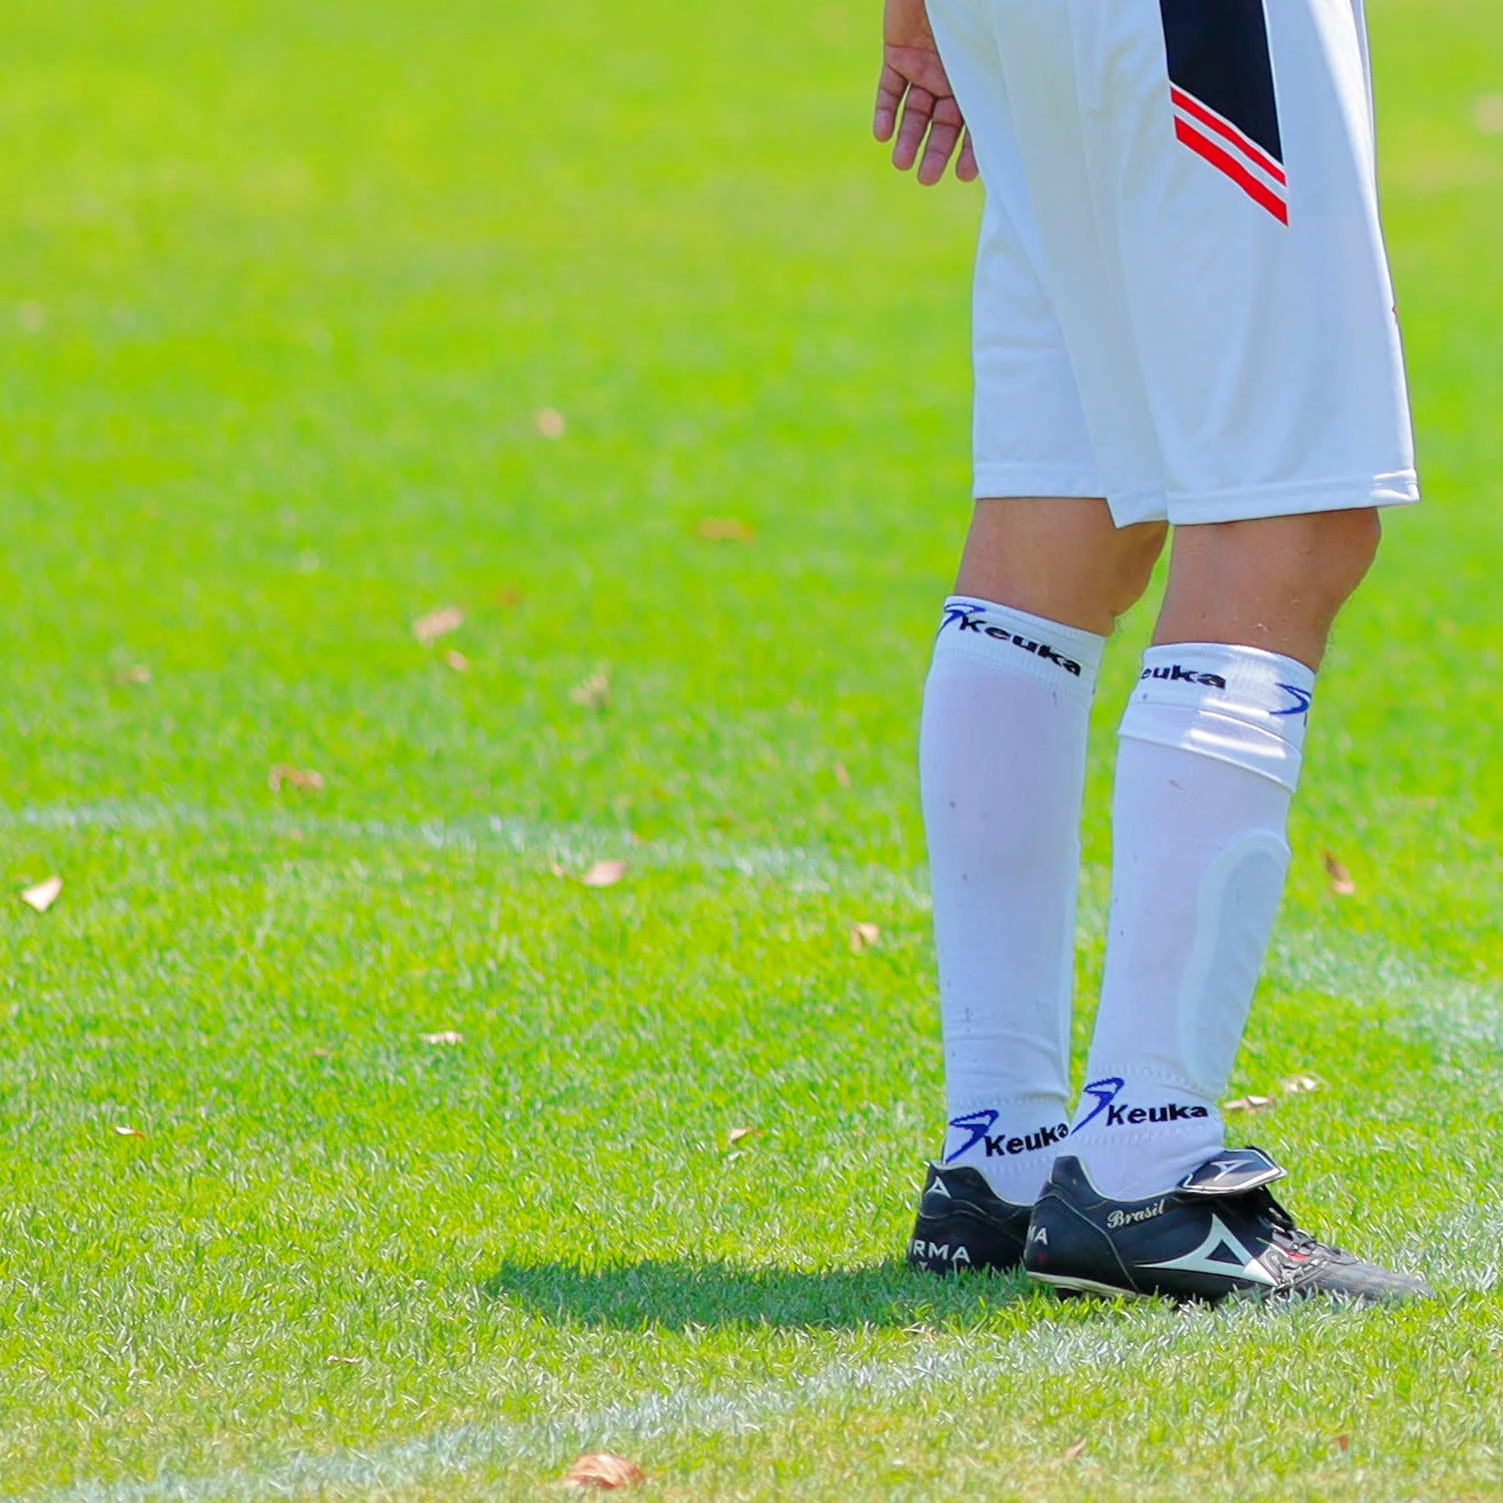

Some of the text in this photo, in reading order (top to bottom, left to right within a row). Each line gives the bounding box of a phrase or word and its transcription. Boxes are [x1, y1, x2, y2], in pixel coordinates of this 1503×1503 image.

[958, 614, 1083, 677] Keuka
[1141, 664, 1227, 690] euka
[1105, 1102, 1209, 1127] Keuka
[983, 1121, 1070, 1158] Keuka
[1106, 1199, 1166, 1229] Brasil
[908, 1237, 971, 1265] RMA
